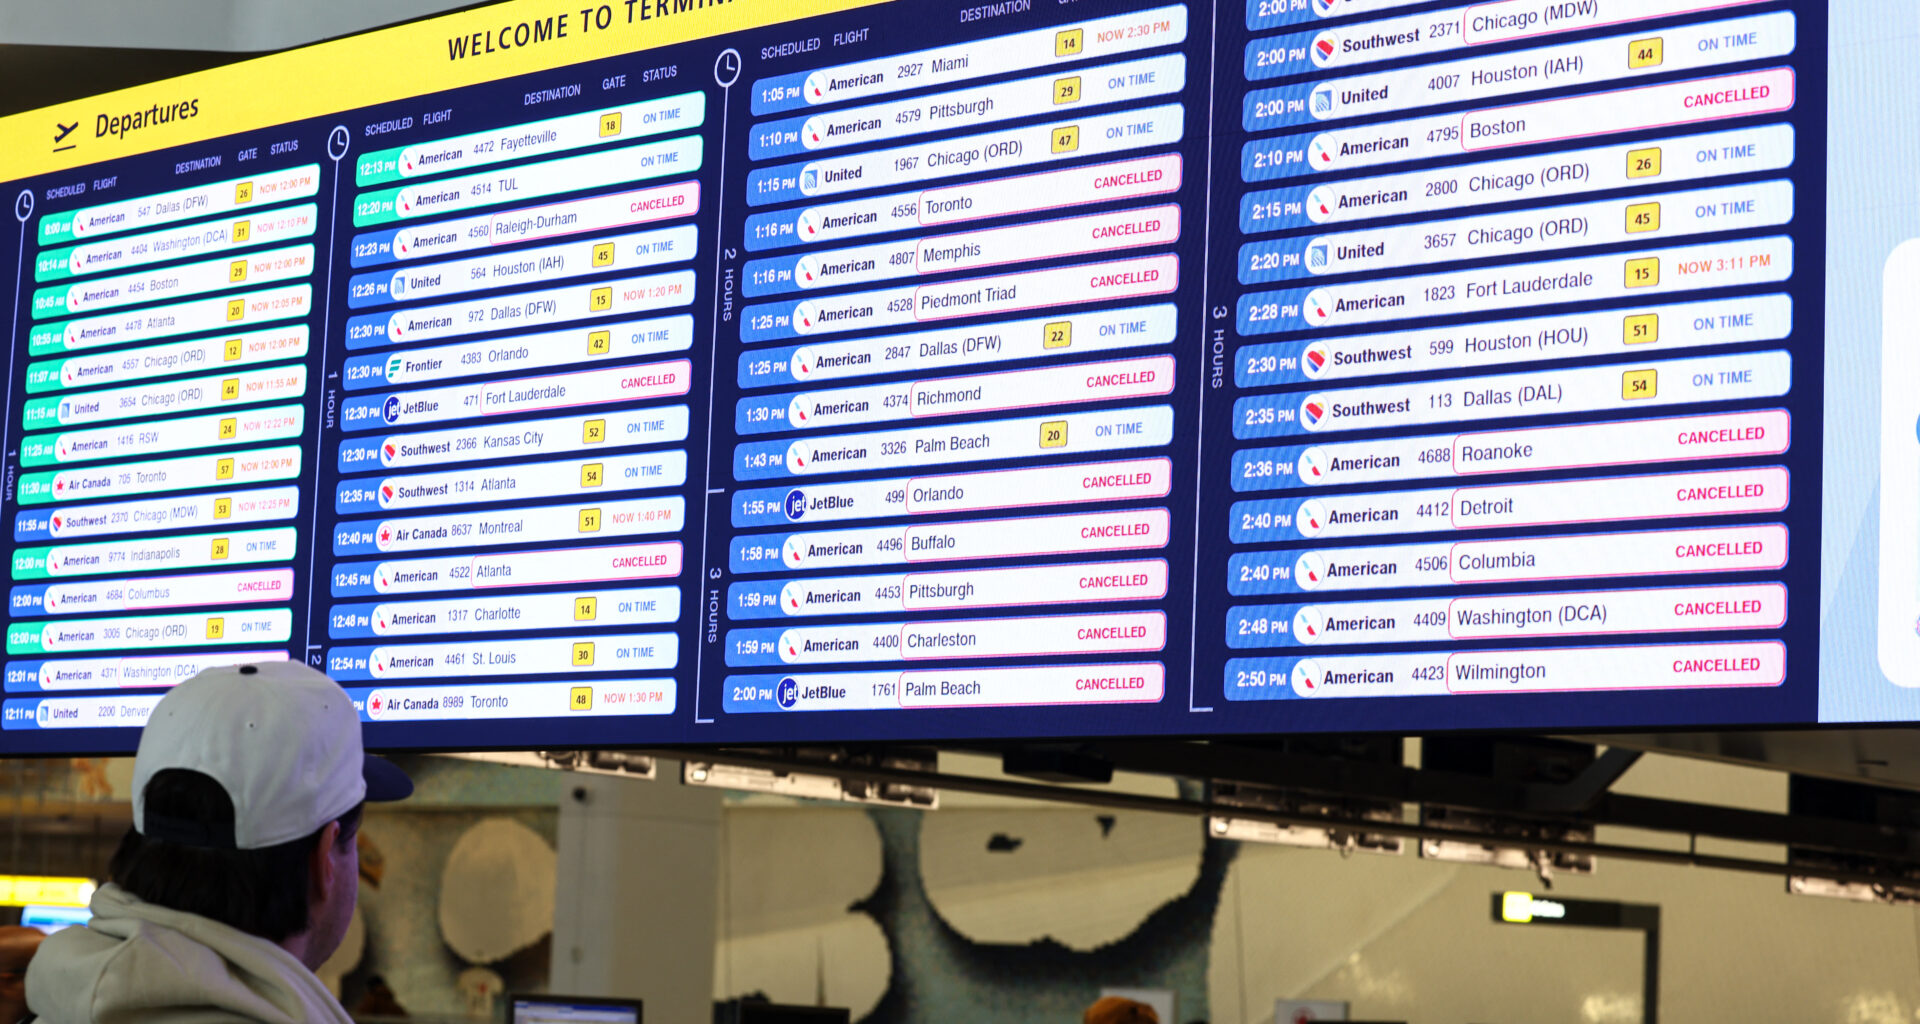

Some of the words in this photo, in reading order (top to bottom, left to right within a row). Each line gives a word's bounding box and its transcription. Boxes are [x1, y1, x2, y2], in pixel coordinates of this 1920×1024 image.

[448, 13, 568, 61] WELCOME
[580, 5, 612, 33] TO
[760, 37, 821, 60] SCHEDULED
[833, 27, 870, 47] FLIGHT
[960, 0, 1031, 23] DESTINATION
[1256, 46, 1286, 67] 2:00
[1287, 46, 1306, 63] PM
[1342, 27, 1420, 53] Southwest
[1428, 20, 1460, 39] 2371
[1472, 10, 1538, 32] Chicago
[1543, 0, 1599, 25] (MDW)
[761, 86, 785, 103] 1:05
[785, 85, 801, 99] PM
[828, 72, 884, 92] American
[896, 62, 924, 79] 2927
[930, 56, 969, 74] Miami
[1063, 37, 1076, 50] 14
[1096, 27, 1125, 44] NOW
[1126, 23, 1151, 39] 2:30
[1152, 19, 1171, 34] PM
[95, 98, 200, 140] Departures
[365, 116, 413, 137] SCHEDULED
[422, 108, 453, 126] FLIGHT
[523, 83, 582, 106] DESTINATION
[602, 74, 627, 90] GATE
[642, 65, 678, 83] STATUS
[1253, 148, 1284, 169] 2:10
[1285, 148, 1304, 164] PM
[1339, 136, 1409, 157] American
[1425, 125, 1459, 143] 4795
[1469, 118, 1526, 139] Boston
[1683, 84, 1771, 109] CANCELLED
[359, 159, 384, 177] 12:13
[383, 159, 397, 172] PM
[417, 149, 463, 166] American
[472, 139, 495, 155] 4472
[499, 129, 557, 152] Fayetteville
[605, 119, 616, 131] 18
[642, 111, 657, 124] ON
[658, 106, 681, 121] TIME
[46, 182, 86, 200] SCHEDULED
[93, 176, 118, 191] FLIGHT
[175, 155, 222, 175] DESTINATION
[238, 148, 258, 162] GATE
[270, 139, 299, 155] STATUS
[354, 241, 378, 258] 12:23
[377, 241, 391, 254] PM
[412, 232, 458, 249] American
[467, 223, 490, 239] 4560
[494, 212, 578, 236] Raleigh-Durham
[629, 193, 685, 214] CANCELLED
[82, 288, 120, 302] American
[127, 281, 145, 294] 4454
[149, 277, 179, 292] Boston
[233, 266, 243, 278] 29
[253, 261, 273, 273] NOW
[292, 255, 306, 267] PM
[724, 247, 737, 260] 2
[722, 268, 734, 322] HOURS
[750, 313, 774, 331] 1:25
[774, 314, 790, 328] PM
[817, 305, 874, 323] American
[886, 296, 913, 313] 4528
[920, 289, 982, 310] Piedmont
[984, 284, 1017, 303] Triad
[1089, 268, 1160, 289] CANCELLED
[1212, 305, 1228, 320] 3
[1248, 302, 1279, 322] 2:28
[1280, 303, 1299, 319] PM
[1334, 293, 1405, 313] American
[1424, 284, 1456, 302] 1823
[1465, 280, 1498, 299] Fort
[1501, 270, 1593, 295] Lauderdale
[1634, 266, 1650, 281] 15
[1677, 259, 1713, 276] NOW
[1715, 255, 1744, 272] 3:11
[1748, 253, 1771, 268] PM
[346, 364, 371, 381] 12:30
[370, 365, 383, 377] PM
[404, 358, 443, 373] Frontier
[459, 350, 482, 365] 4383
[487, 345, 529, 363] Orlando
[592, 338, 604, 349] 42
[630, 332, 646, 345] ON
[646, 328, 670, 343] TIME
[1211, 328, 1225, 389] HOURS
[326, 389, 336, 429] HOUR
[1244, 407, 1275, 426] 2:35
[1276, 408, 1296, 423] PM
[1331, 397, 1411, 418] Southwest
[1429, 392, 1453, 409] 113
[1462, 388, 1512, 407] Dallas
[1517, 383, 1563, 407] (DAL)
[1631, 378, 1648, 392] 54
[1691, 372, 1714, 387] ON
[1717, 369, 1752, 385] TIME
[341, 447, 366, 463] 12:30
[365, 448, 379, 460] PM
[400, 440, 451, 457] Southwest
[455, 436, 478, 451] 2366
[482, 434, 521, 449] Kansas
[522, 430, 544, 448] City
[588, 426, 599, 438] 52
[626, 421, 641, 434] ON
[642, 418, 665, 432] TIME
[5, 465, 14, 501] HOUR
[741, 499, 765, 516] 1:55
[765, 500, 781, 514] PM
[808, 494, 854, 511] JetBlue
[884, 488, 905, 504] 499
[912, 484, 964, 503] Orlando
[1081, 471, 1152, 489] CANCELLED
[65, 514, 107, 528] Southwest
[109, 510, 129, 524] 2370
[132, 509, 168, 524] Chicago
[169, 504, 199, 519] (MDW)
[217, 503, 227, 515] 53
[237, 501, 257, 512] NOW
[277, 497, 291, 509] PM
[59, 593, 98, 604] American
[105, 588, 124, 601] 4684
[127, 587, 171, 601] Columbus
[237, 579, 282, 593] CANCELLED
[709, 567, 722, 580] 3
[707, 589, 719, 644] HOURS
[735, 639, 759, 655] 1:59
[760, 641, 775, 654] PM
[802, 638, 859, 653] American
[871, 633, 900, 649] 4400
[906, 631, 977, 649] Charleston
[1076, 624, 1147, 640] CANCELLED
[1236, 669, 1267, 688] 2:50
[1268, 672, 1287, 687] PM
[1322, 669, 1394, 685] American
[1410, 664, 1445, 681] 4423
[1454, 662, 1546, 684] Wilmington
[1672, 657, 1761, 673] CANCELLED
